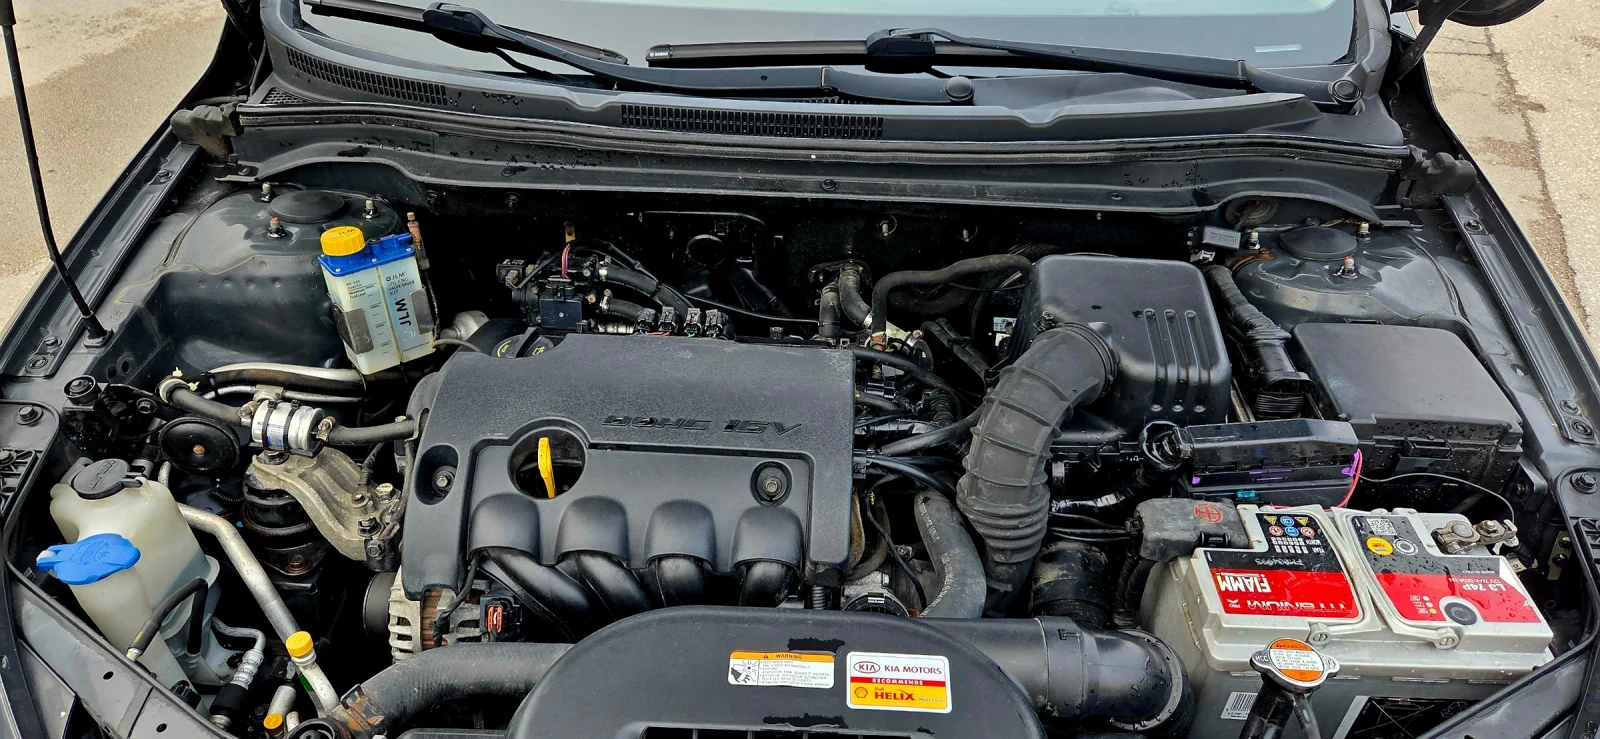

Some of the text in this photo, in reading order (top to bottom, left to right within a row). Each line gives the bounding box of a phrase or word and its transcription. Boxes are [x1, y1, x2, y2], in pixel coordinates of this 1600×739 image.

[395, 298, 411, 326] JLM
[602, 415, 711, 430] DOHC
[1216, 573, 1272, 593] FIAMM
[1462, 583, 1507, 592] L3 74P
[859, 663, 942, 675] KIA KIA MOTORS
[874, 691, 915, 701] HELIX
